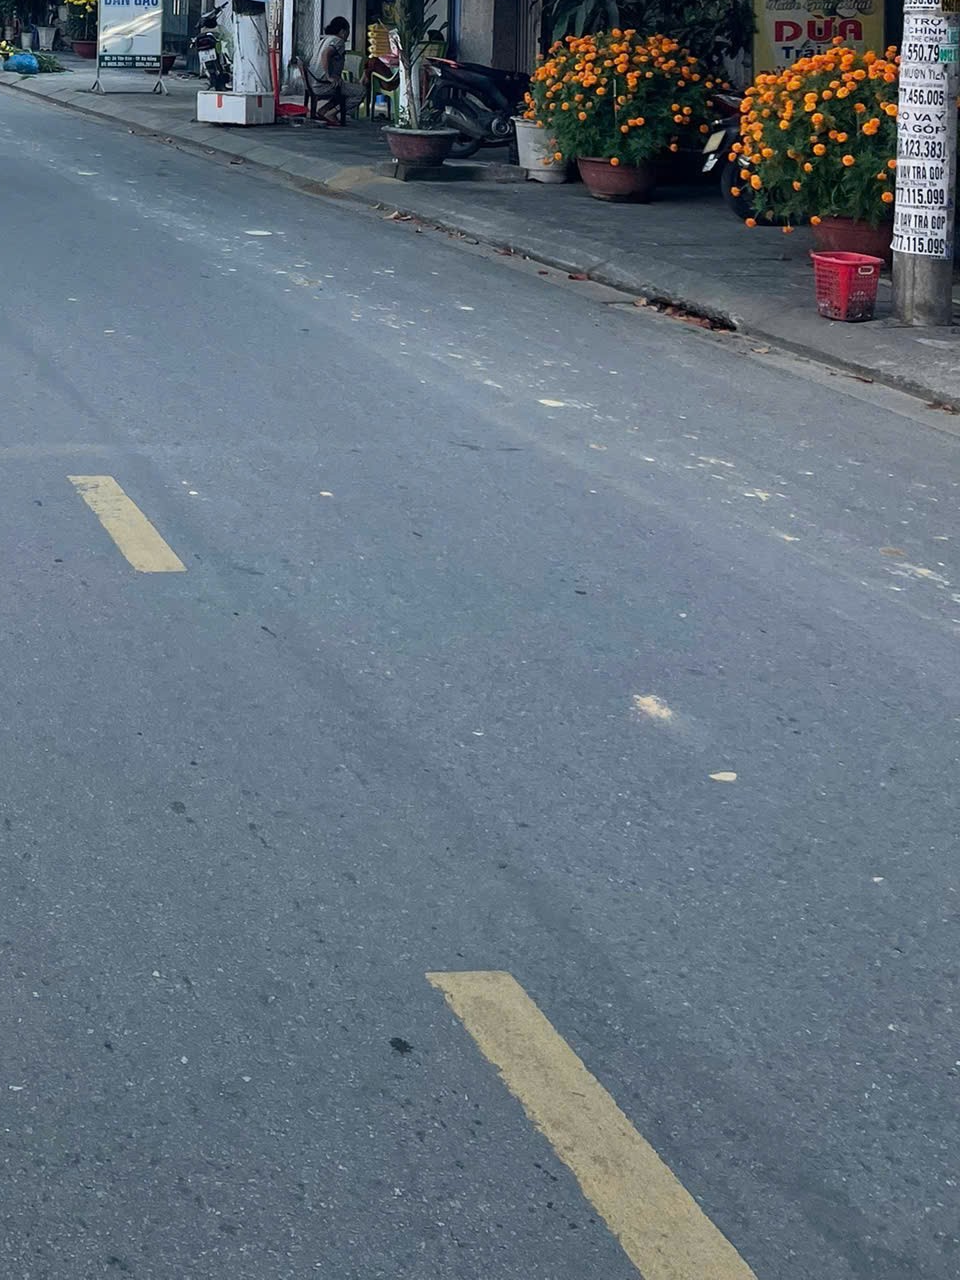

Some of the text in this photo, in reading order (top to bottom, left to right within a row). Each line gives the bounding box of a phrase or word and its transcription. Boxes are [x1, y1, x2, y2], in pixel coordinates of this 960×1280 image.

[774, 14, 863, 42] DỪA
[914, 17, 943, 27] TRỢ
[912, 123, 947, 134] GÓP
[912, 162, 927, 180] TRẢ
[914, 211, 928, 229] TRẢ
